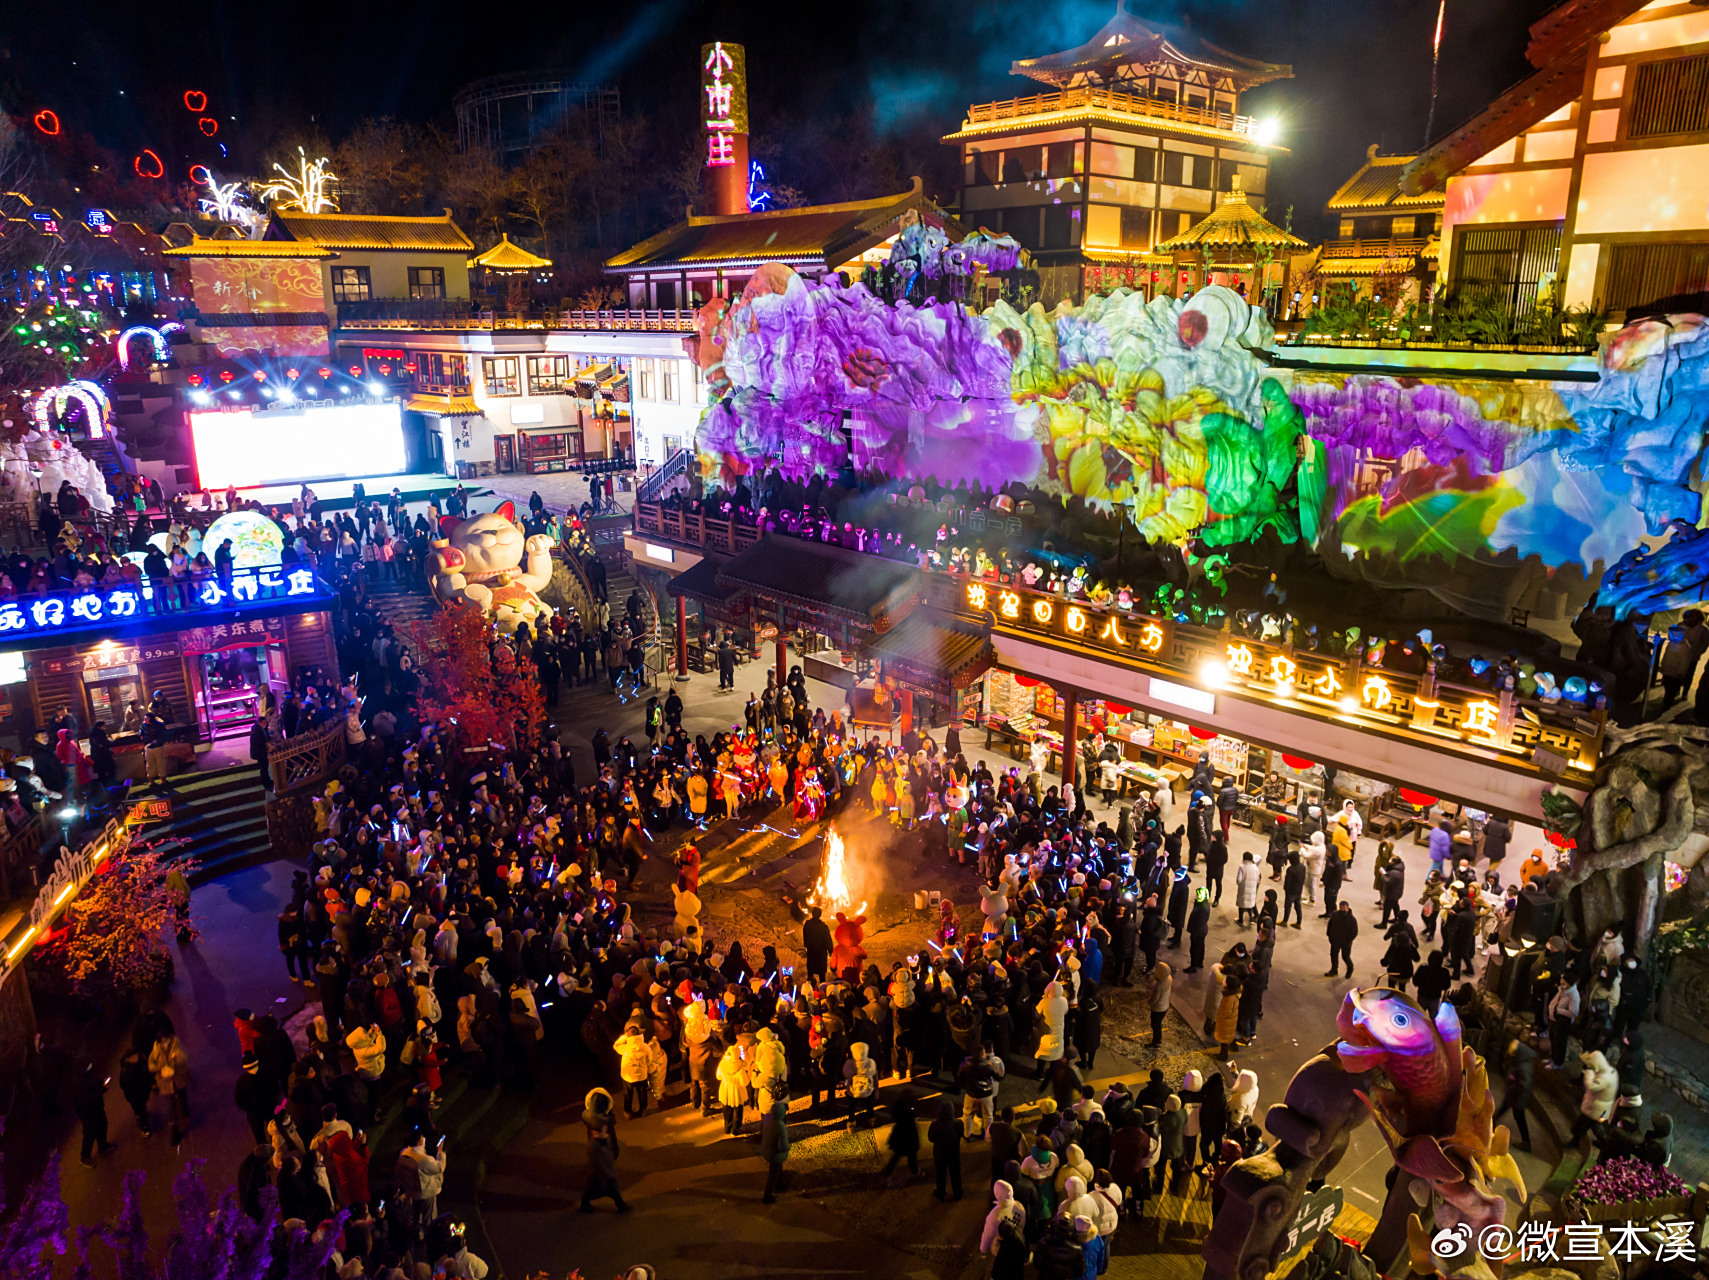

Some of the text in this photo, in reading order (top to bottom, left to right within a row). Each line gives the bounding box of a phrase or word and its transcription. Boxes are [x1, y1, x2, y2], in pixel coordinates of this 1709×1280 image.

[705, 41, 735, 167] 小市一庄
[460, 419, 471, 449] 望江楼
[127, 802, 170, 820] 冰吧
